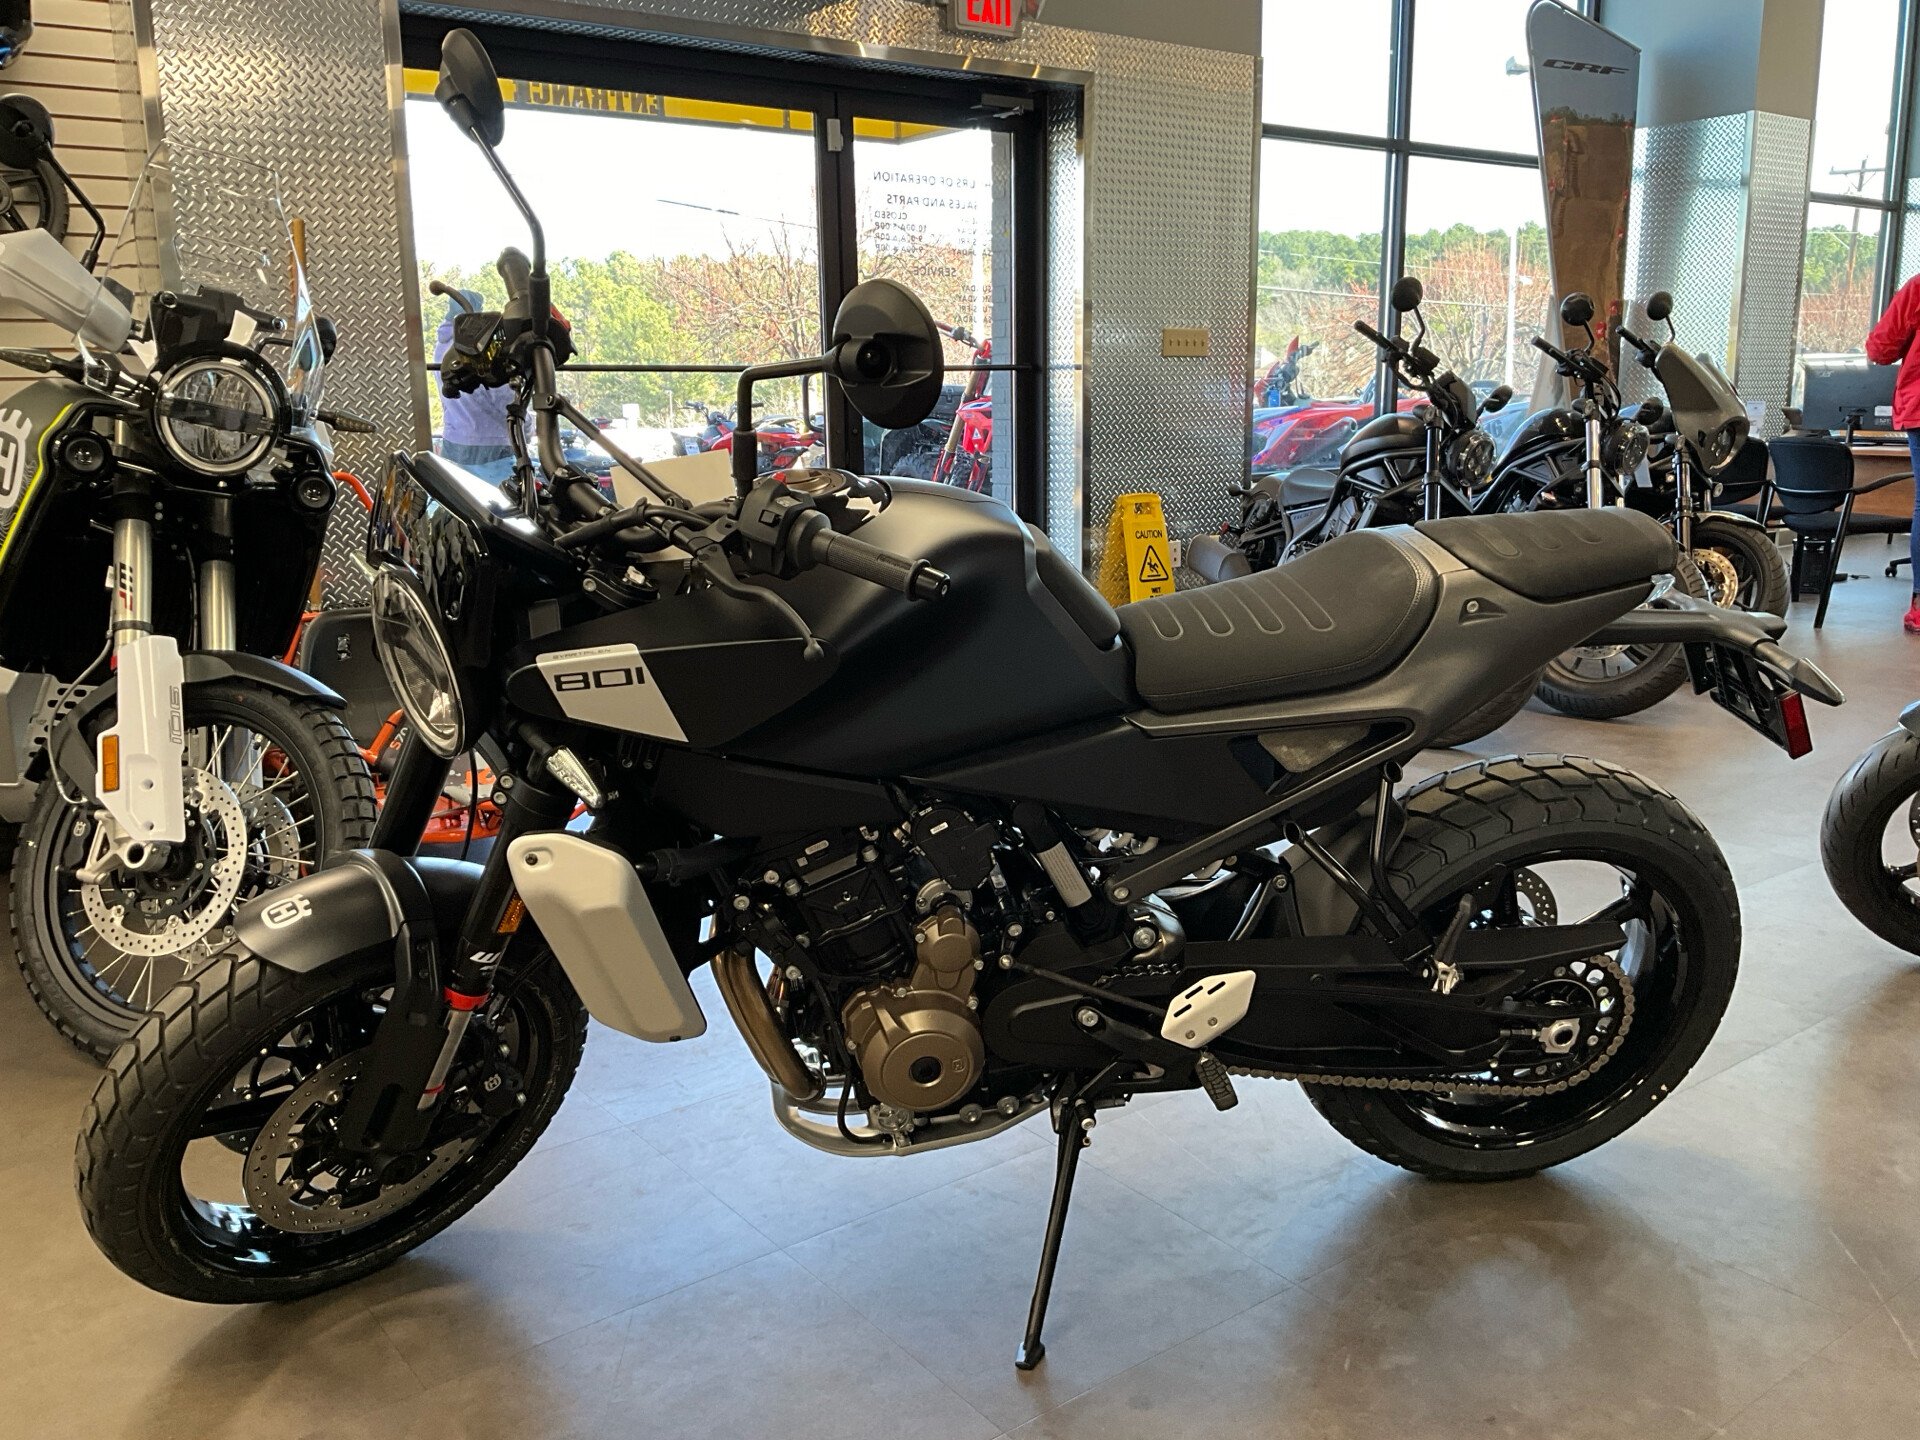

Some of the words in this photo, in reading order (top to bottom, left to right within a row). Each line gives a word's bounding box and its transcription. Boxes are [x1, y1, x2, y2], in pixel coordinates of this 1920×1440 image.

[1543, 59, 1630, 75] CRF
[1135, 529, 1163, 540] CAUTION
[553, 666, 646, 692] 801
